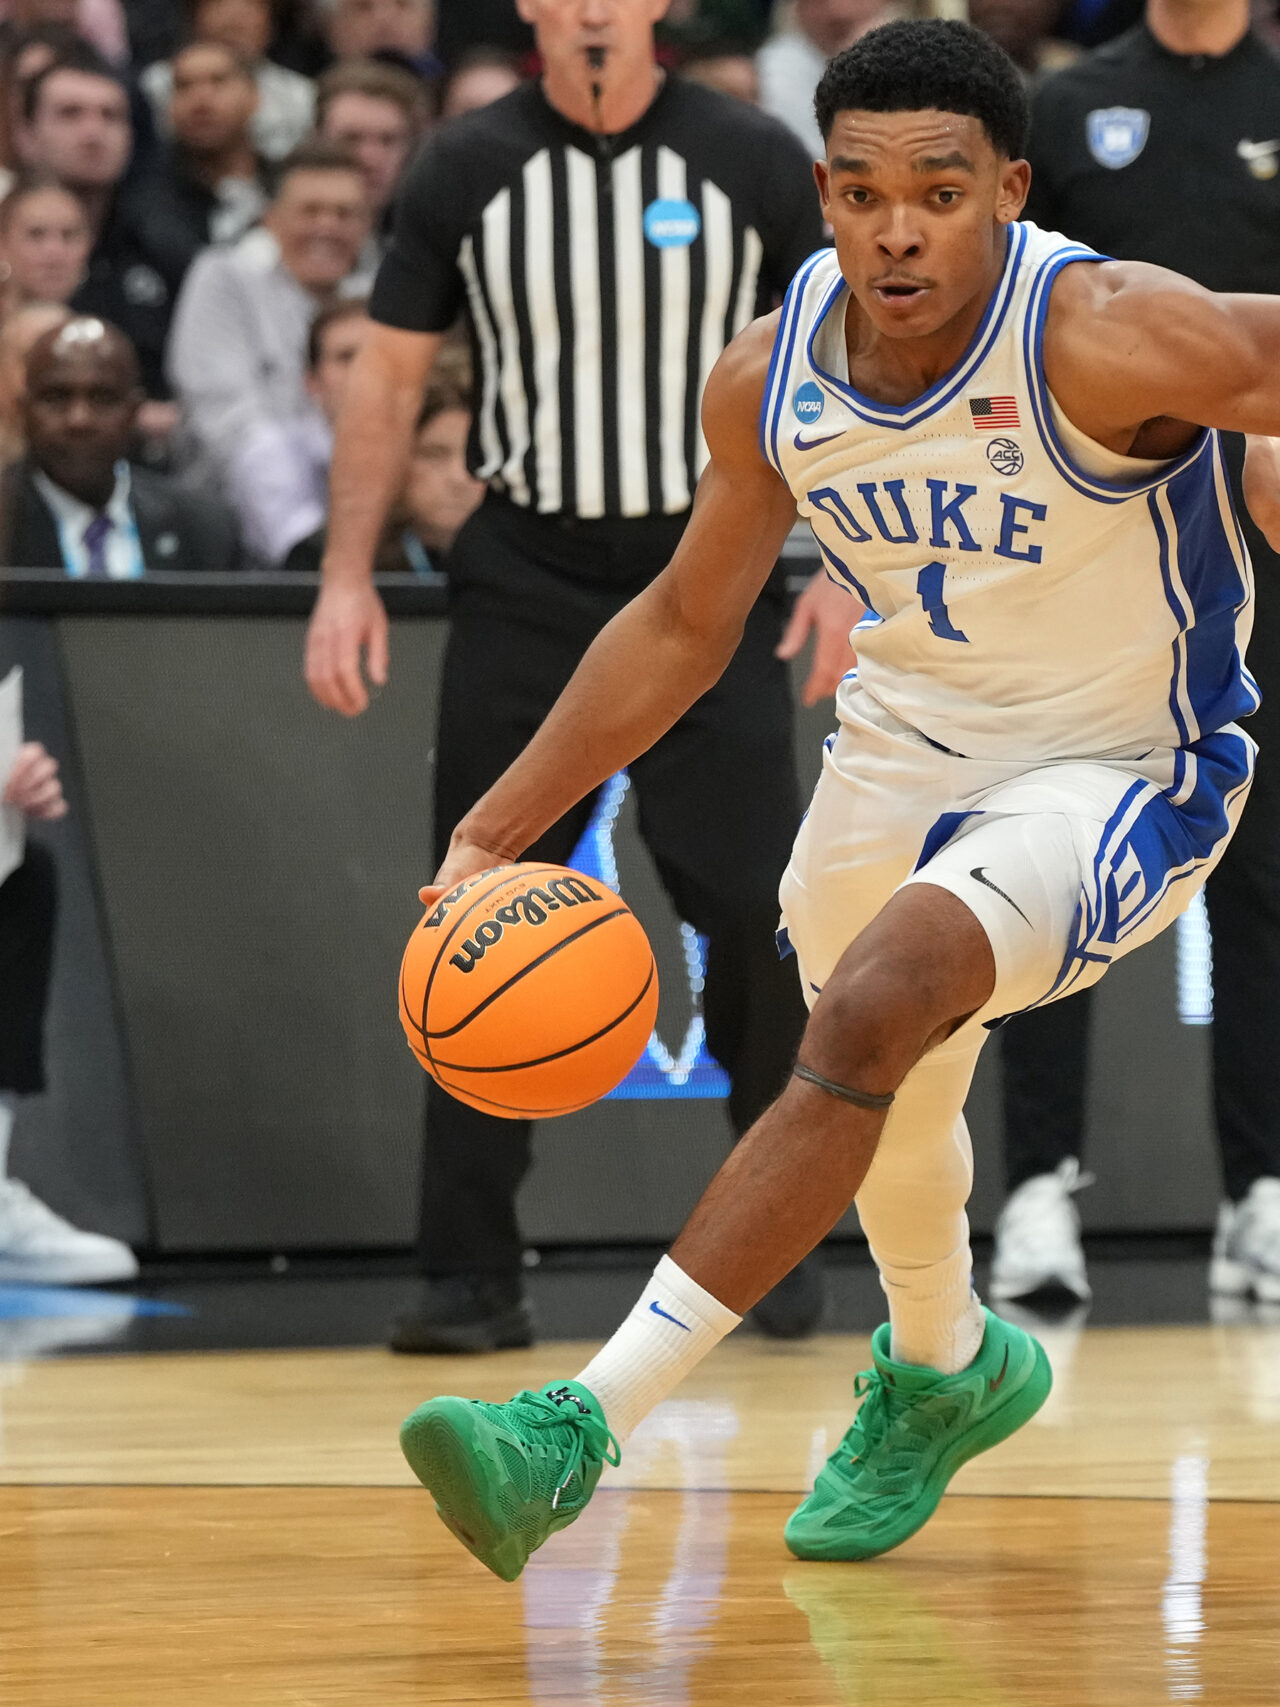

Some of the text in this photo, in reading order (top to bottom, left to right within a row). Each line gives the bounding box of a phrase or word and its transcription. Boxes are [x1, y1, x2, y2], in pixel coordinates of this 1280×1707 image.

[797, 401, 822, 412] NCAA
[992, 450, 1020, 460] ACC
[807, 478, 1048, 564] DUKE
[916, 561, 970, 643] 1
[449, 876, 604, 974] Wilson
